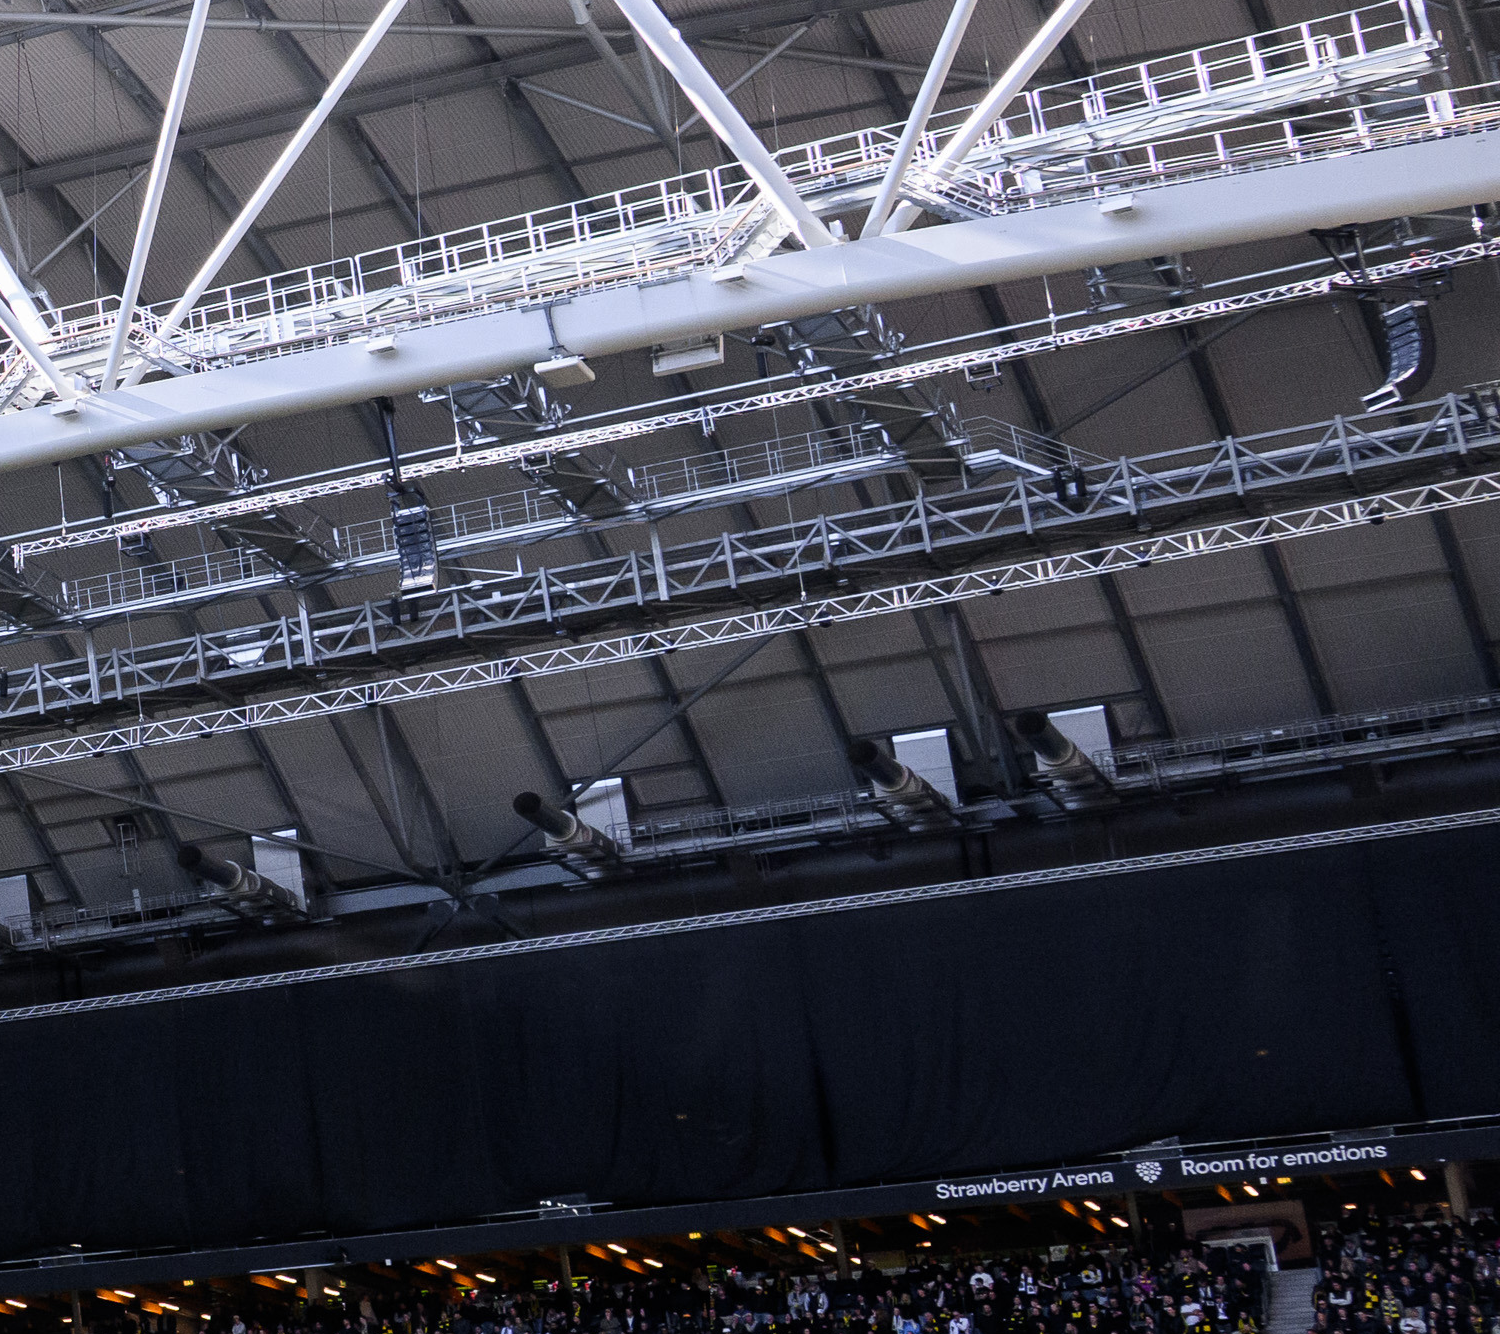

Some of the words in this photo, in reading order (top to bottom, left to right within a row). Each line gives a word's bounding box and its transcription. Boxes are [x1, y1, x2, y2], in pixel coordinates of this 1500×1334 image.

[1181, 1156, 1244, 1177] Room
[1247, 1152, 1279, 1172] for
[1282, 1144, 1389, 1170] emotions
[936, 1179, 1052, 1201] Strawberry
[1053, 1169, 1116, 1194] Arena
